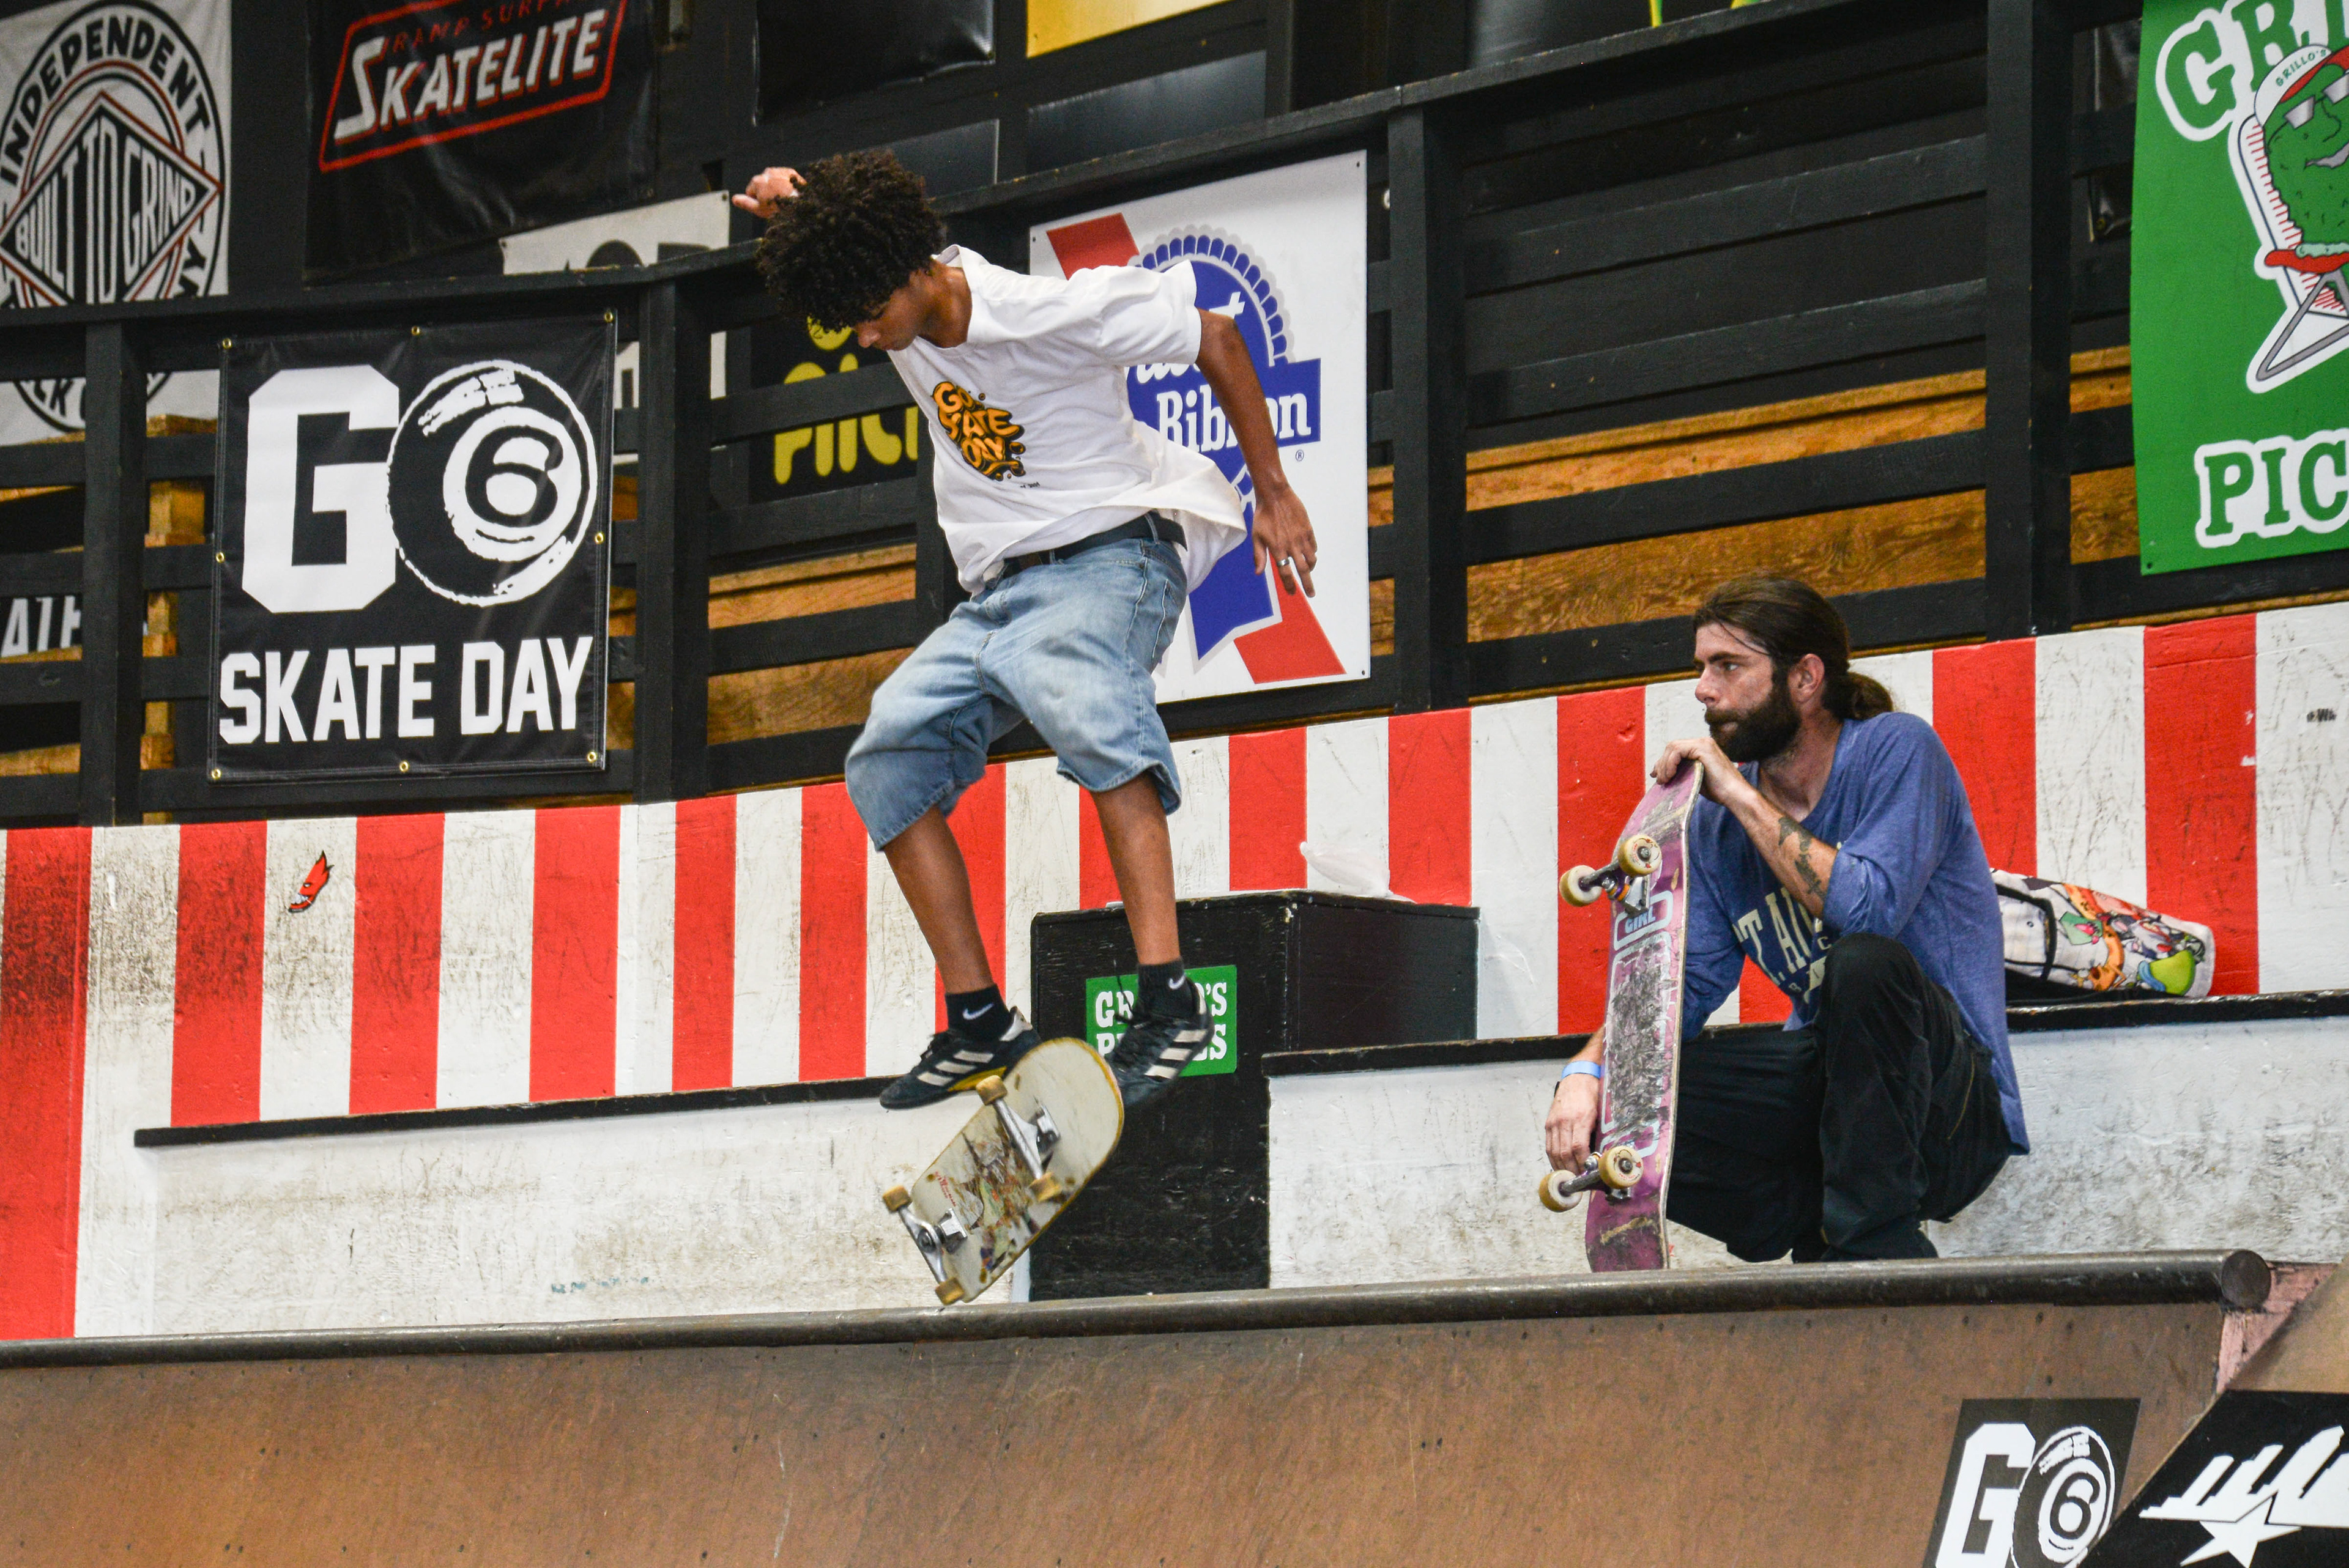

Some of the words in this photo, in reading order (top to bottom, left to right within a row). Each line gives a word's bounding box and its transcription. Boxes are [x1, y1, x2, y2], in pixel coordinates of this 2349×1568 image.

[333, 9, 610, 145] SKATELITE
[393, 21, 470, 53] RAMP
[2276, 48, 2327, 87] GRILLO'S
[0, 15, 210, 187] INDEPENDENT
[15, 144, 81, 300] BUILT
[83, 115, 119, 304] TO
[124, 135, 196, 286] GRIND
[220, 645, 436, 744] SKATE
[460, 636, 593, 735] DAY
